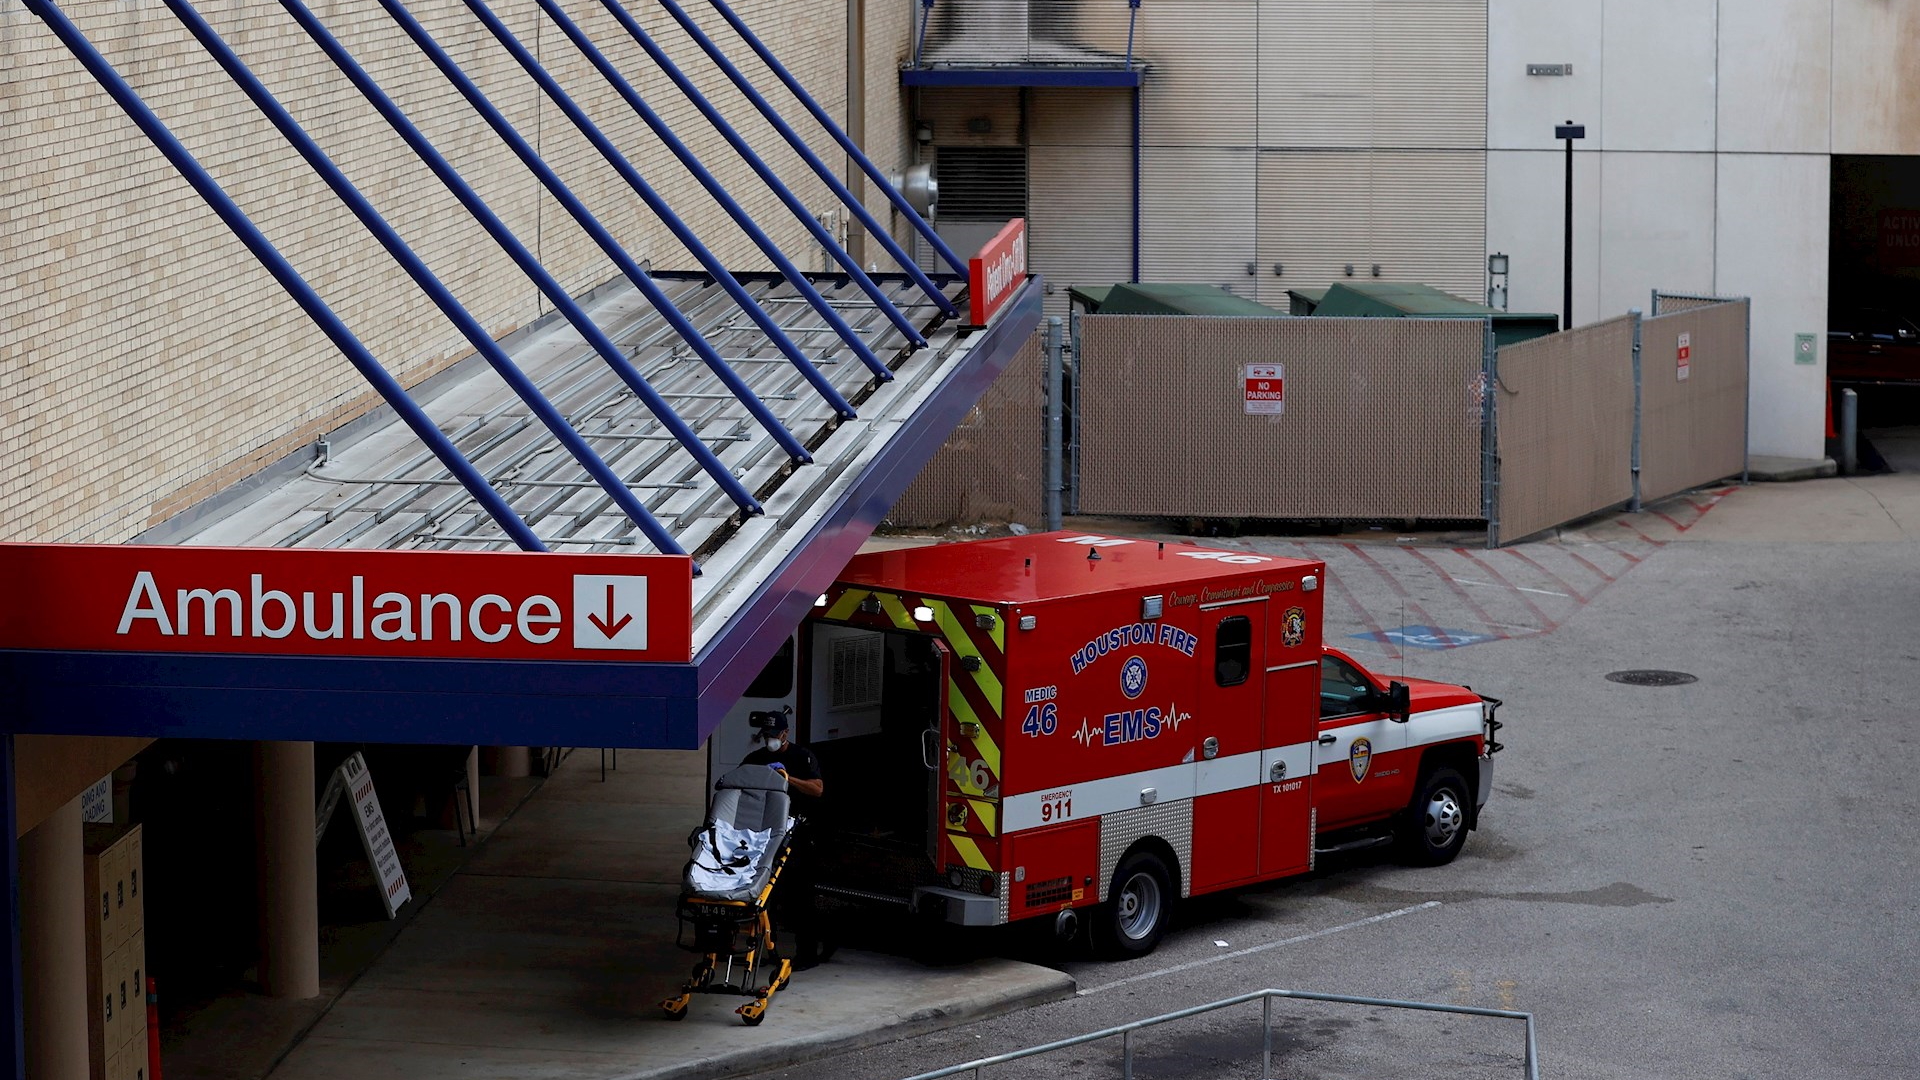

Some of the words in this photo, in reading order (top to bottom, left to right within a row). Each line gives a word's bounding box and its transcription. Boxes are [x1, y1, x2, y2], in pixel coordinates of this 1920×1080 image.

[1258, 382, 1270, 390] NO
[1247, 391, 1281, 400] PARKING
[1056, 535, 1136, 547] M
[1176, 551, 1272, 564] 46
[1200, 586, 1241, 603] Commitment
[1242, 581, 1255, 597] and
[1256, 579, 1295, 596] Compassion
[116, 571, 562, 644] Ambulance
[1070, 623, 1156, 675] HOUSTON
[1158, 624, 1198, 658] FIRE
[1025, 685, 1056, 702] MEDIC
[1022, 703, 1058, 738] 46
[1103, 707, 1161, 745] EMS
[949, 756, 990, 790] 46
[96, 781, 106, 799] AND
[1041, 789, 1073, 802] EMERGENCY
[1273, 785, 1282, 794] TX
[1282, 781, 1302, 793] 101017
[1041, 799, 1073, 822] 911
